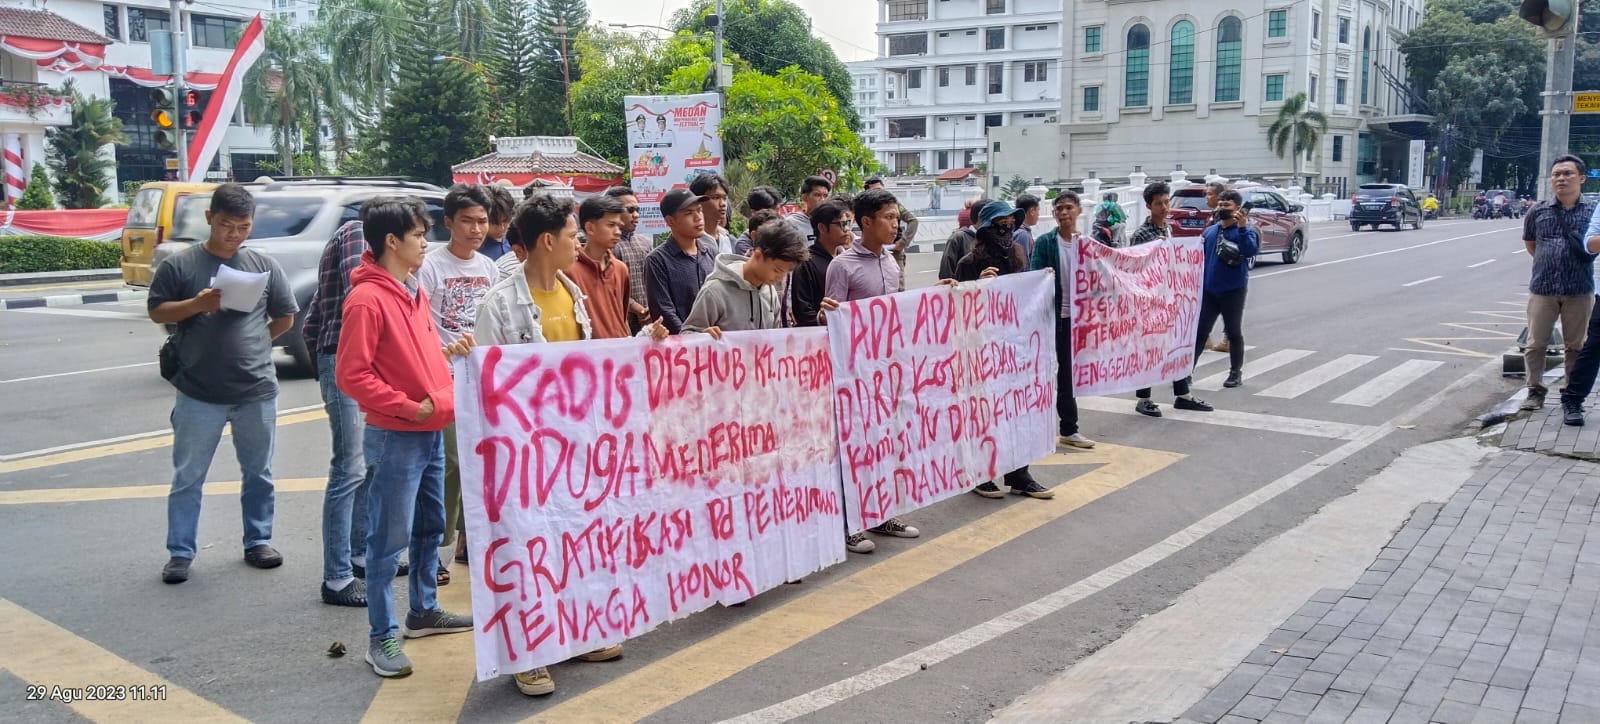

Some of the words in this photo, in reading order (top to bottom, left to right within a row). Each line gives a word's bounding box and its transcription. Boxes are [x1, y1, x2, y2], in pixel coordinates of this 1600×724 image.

[674, 106, 707, 118] MEDAN
[849, 296, 904, 372] ADA
[911, 292, 957, 345] APA
[479, 346, 635, 432] KADIS
[644, 346, 746, 411] DISHUB
[837, 362, 903, 443] DPRD
[911, 350, 965, 412] KOTA
[948, 396, 991, 443] DPRD
[484, 508, 692, 602] GRATIFIKASI
[483, 583, 650, 661] TENAGA
[667, 552, 755, 612] HONOR
